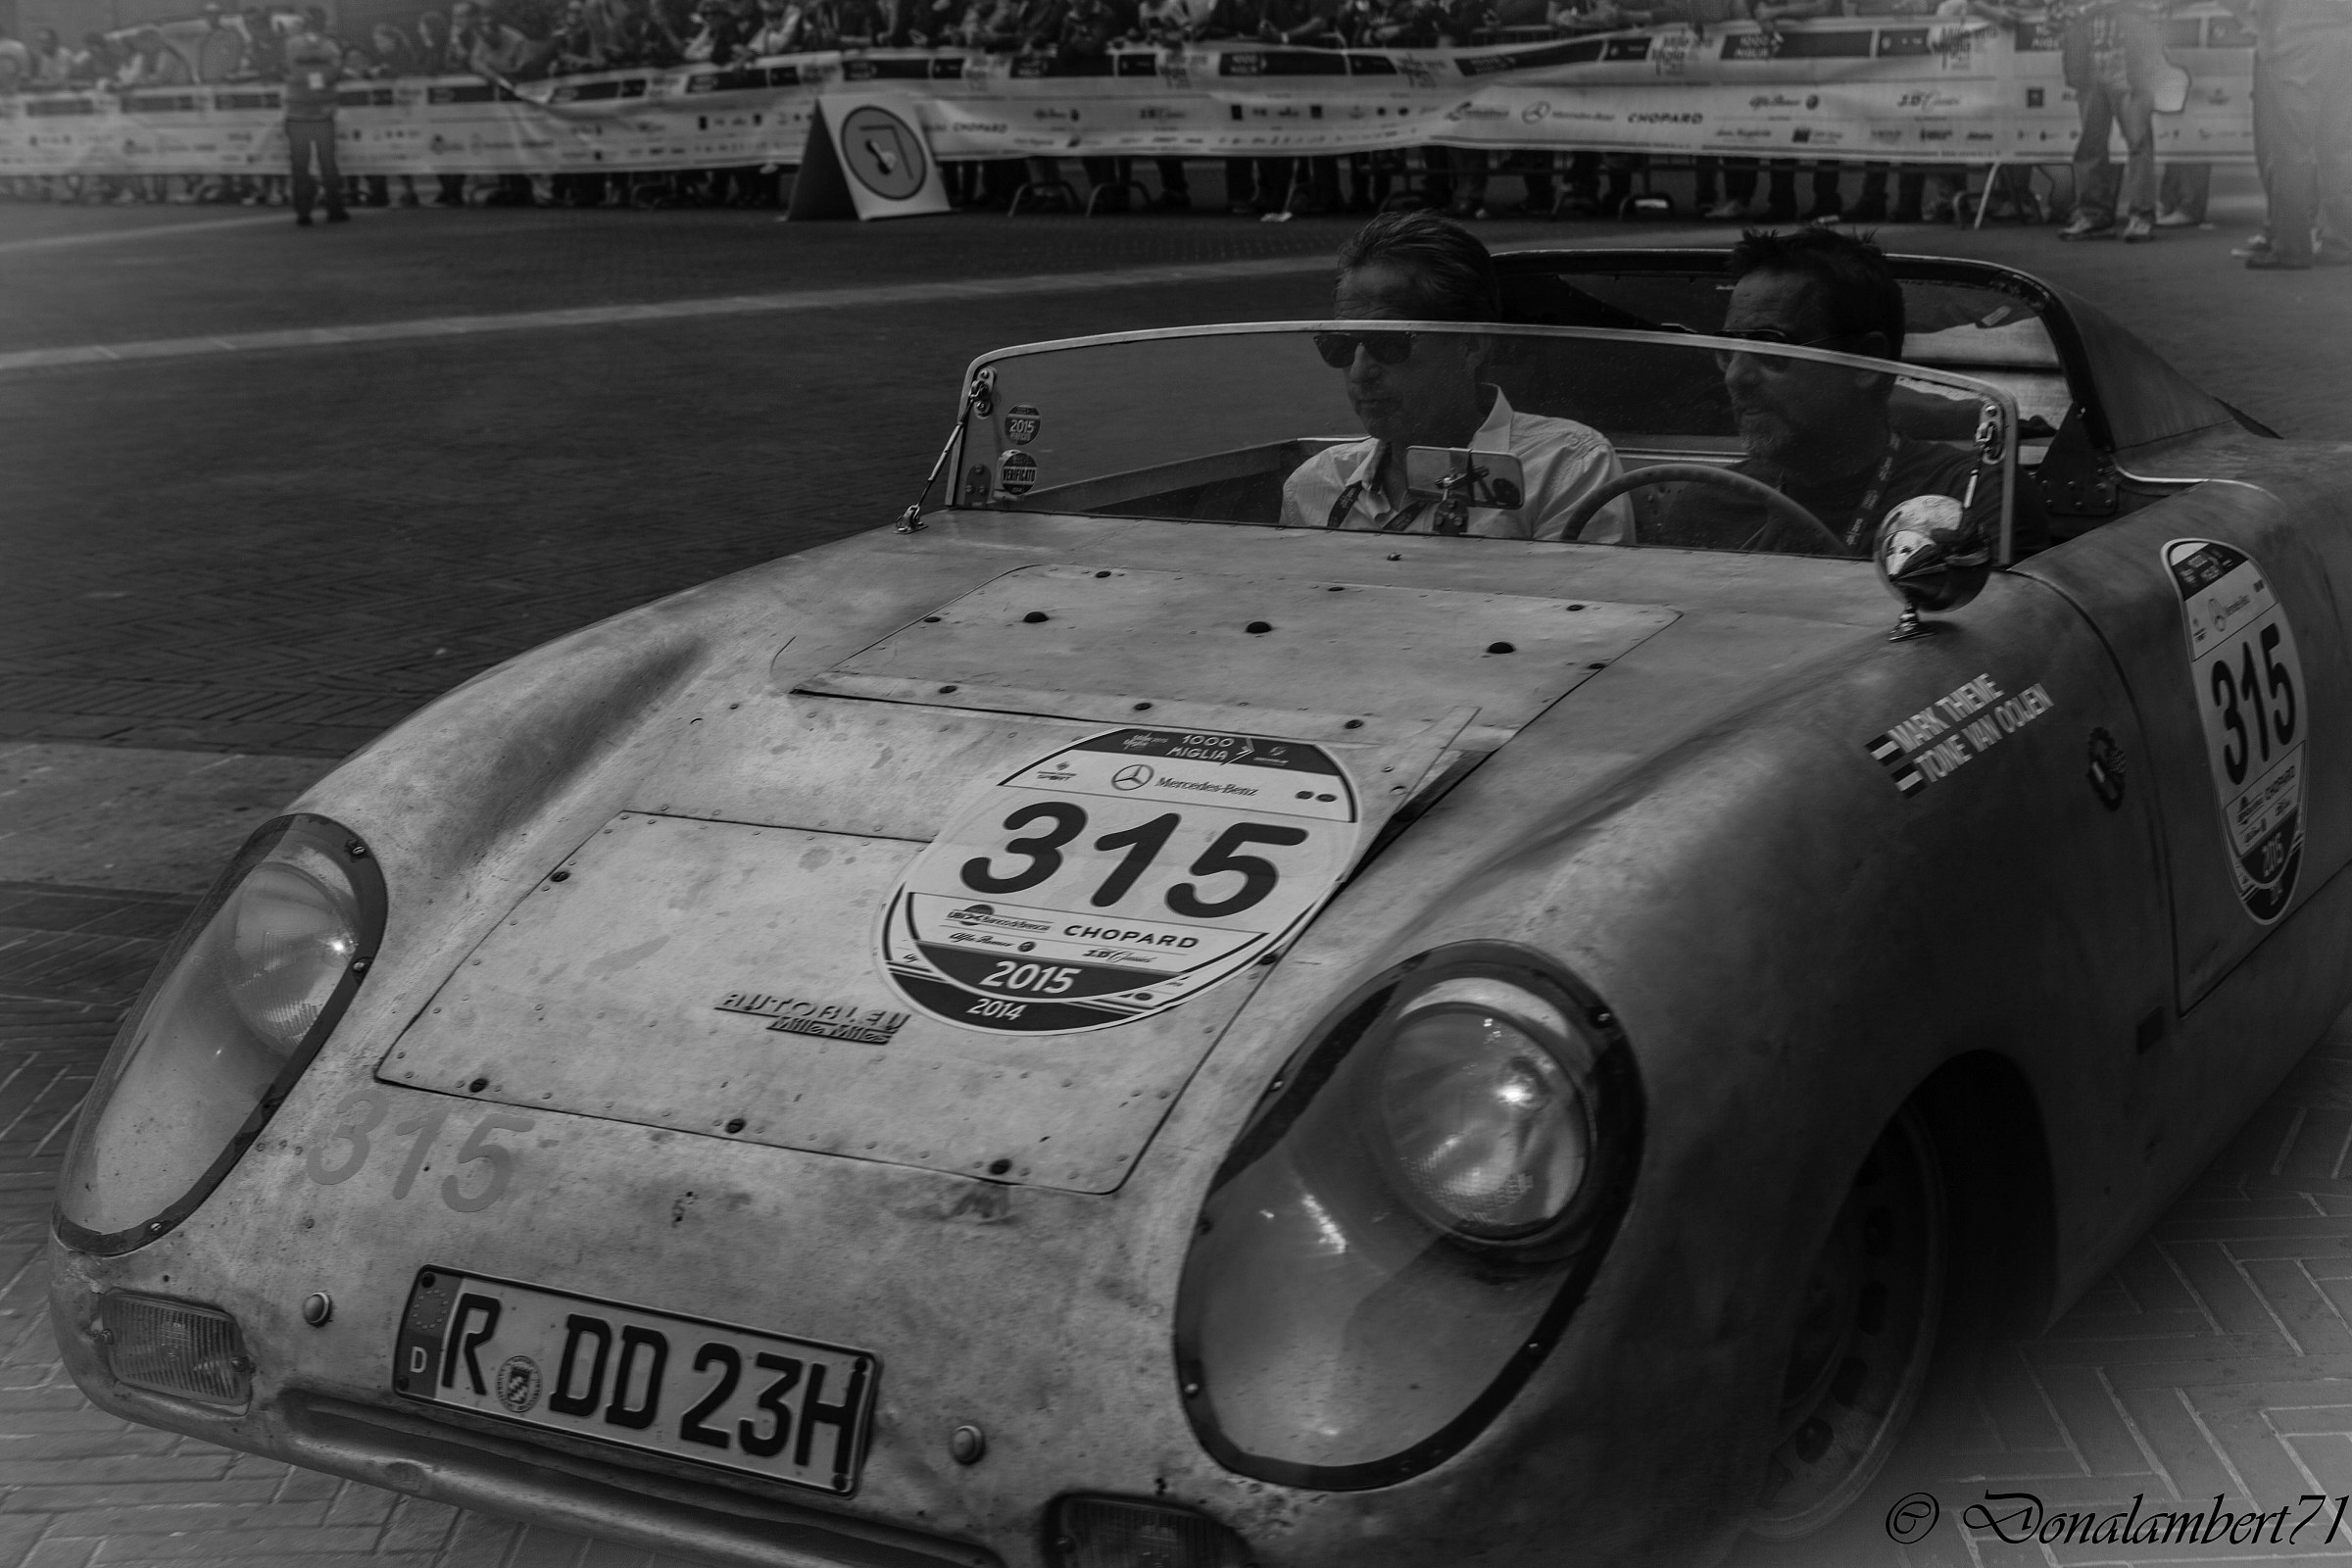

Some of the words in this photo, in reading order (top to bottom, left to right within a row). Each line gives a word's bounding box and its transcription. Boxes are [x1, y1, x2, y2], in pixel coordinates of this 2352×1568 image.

[1628, 112, 1704, 123] CHOPARD
[1009, 418, 1035, 433] 2015
[2212, 622, 2296, 786] 315
[1181, 734, 1236, 748] 1000
[1886, 707, 1951, 753] MARK
[1960, 713, 2003, 753] VAN
[1165, 747, 1230, 761] MIGLIA
[1154, 776, 1259, 798] Mercedes-Benz
[960, 800, 1308, 918] 315
[1063, 924, 1200, 950] CHOPARD
[979, 960, 1083, 994] 2015
[723, 993, 911, 1031] AUTOBLEU
[966, 998, 1029, 1020] 2014
[306, 1089, 536, 1213] 315
[410, 1347, 428, 1374] D
[442, 1293, 501, 1396] R
[549, 1313, 669, 1430] DD
[679, 1342, 864, 1475] 23H
